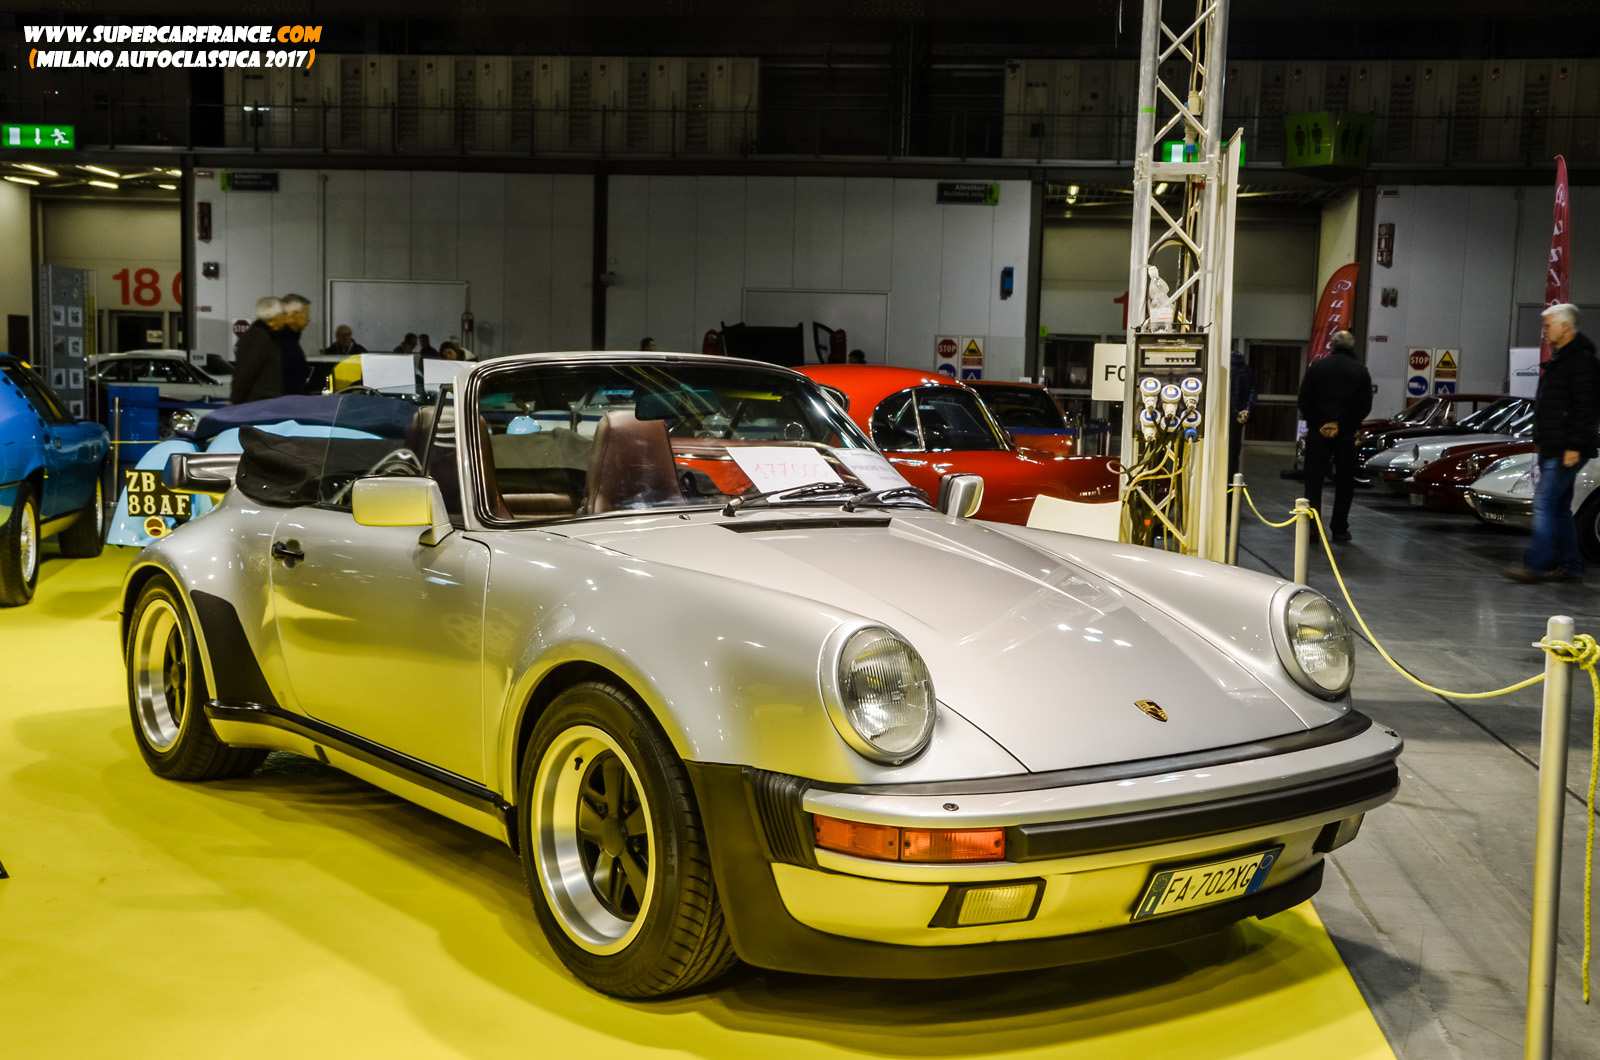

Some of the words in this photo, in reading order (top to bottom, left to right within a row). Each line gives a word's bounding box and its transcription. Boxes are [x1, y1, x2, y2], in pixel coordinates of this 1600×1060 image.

[112, 268, 162, 307] 18
[938, 344, 957, 353] STOP
[1410, 356, 1430, 365] STOP
[126, 470, 156, 492] ZB
[128, 494, 190, 515] 88AF
